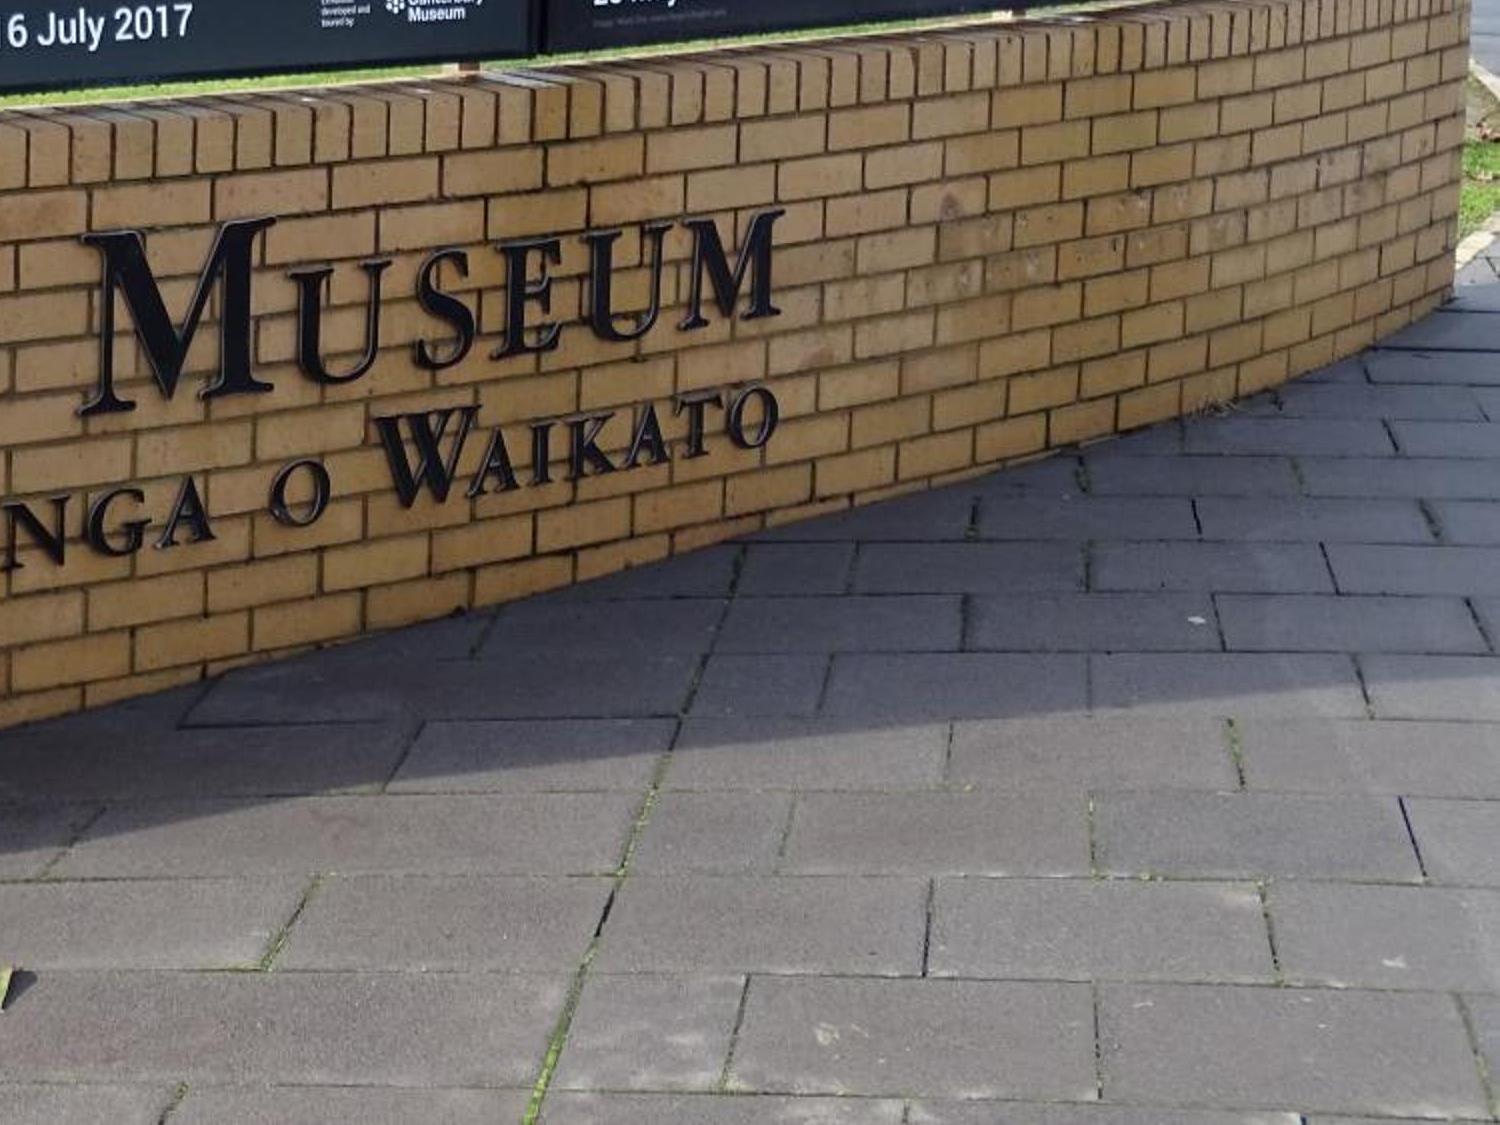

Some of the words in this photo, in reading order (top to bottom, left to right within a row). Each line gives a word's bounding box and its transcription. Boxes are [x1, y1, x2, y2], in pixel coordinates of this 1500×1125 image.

[37, 7, 104, 53] July
[114, 3, 193, 41] 2017
[407, 7, 466, 23] Museum
[75, 208, 785, 417] MUSEUM
[374, 382, 779, 509] WAIKATO
